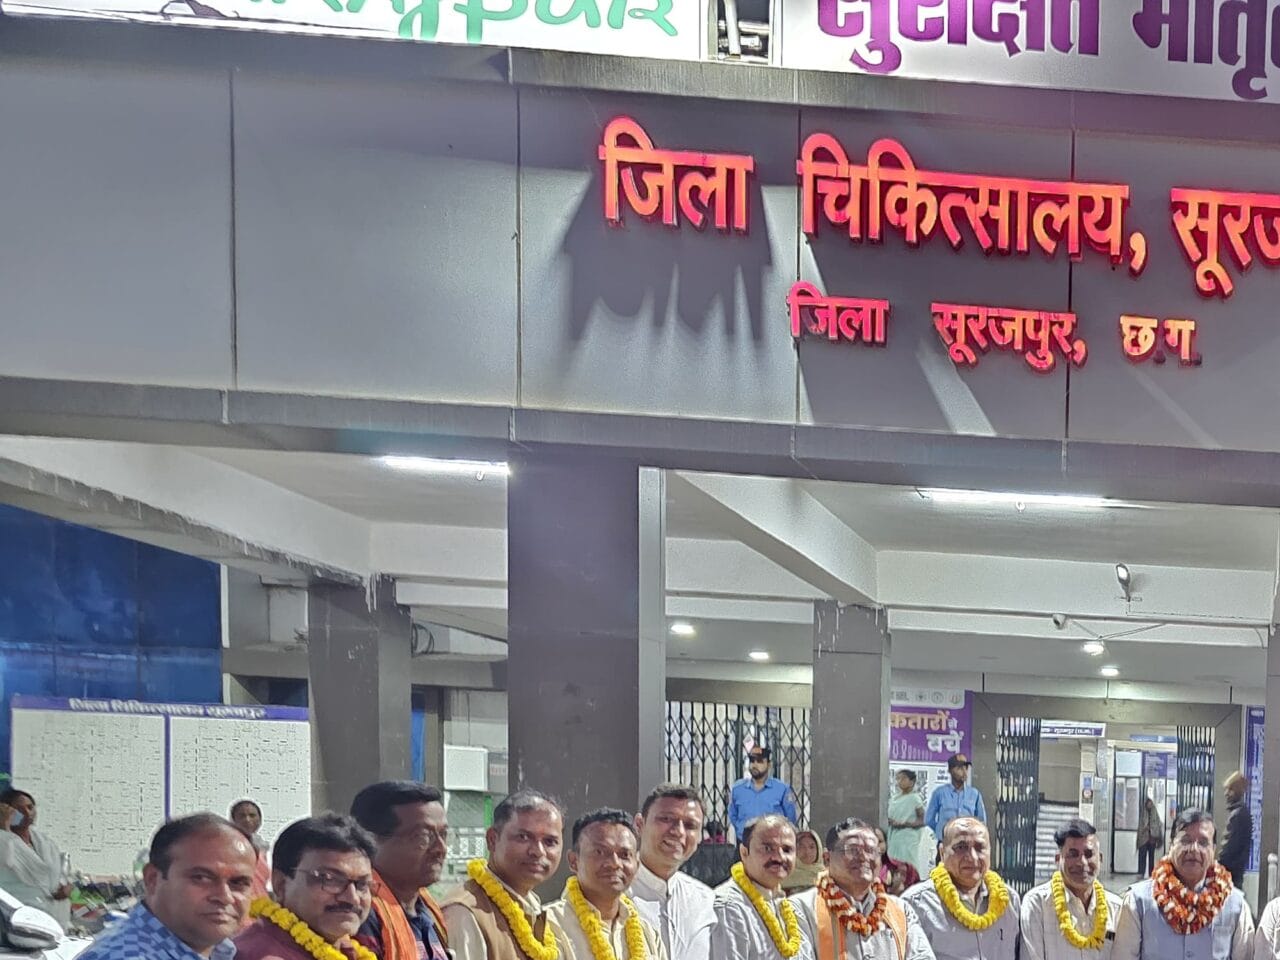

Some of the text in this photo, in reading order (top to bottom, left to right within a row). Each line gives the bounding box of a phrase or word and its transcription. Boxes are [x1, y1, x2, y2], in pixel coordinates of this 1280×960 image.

[598, 115, 754, 234] जिला
[796, 131, 1148, 278] चिकित्सालय,
[786, 280, 891, 346] जिला
[930, 302, 1088, 374] सूरजपुर,
